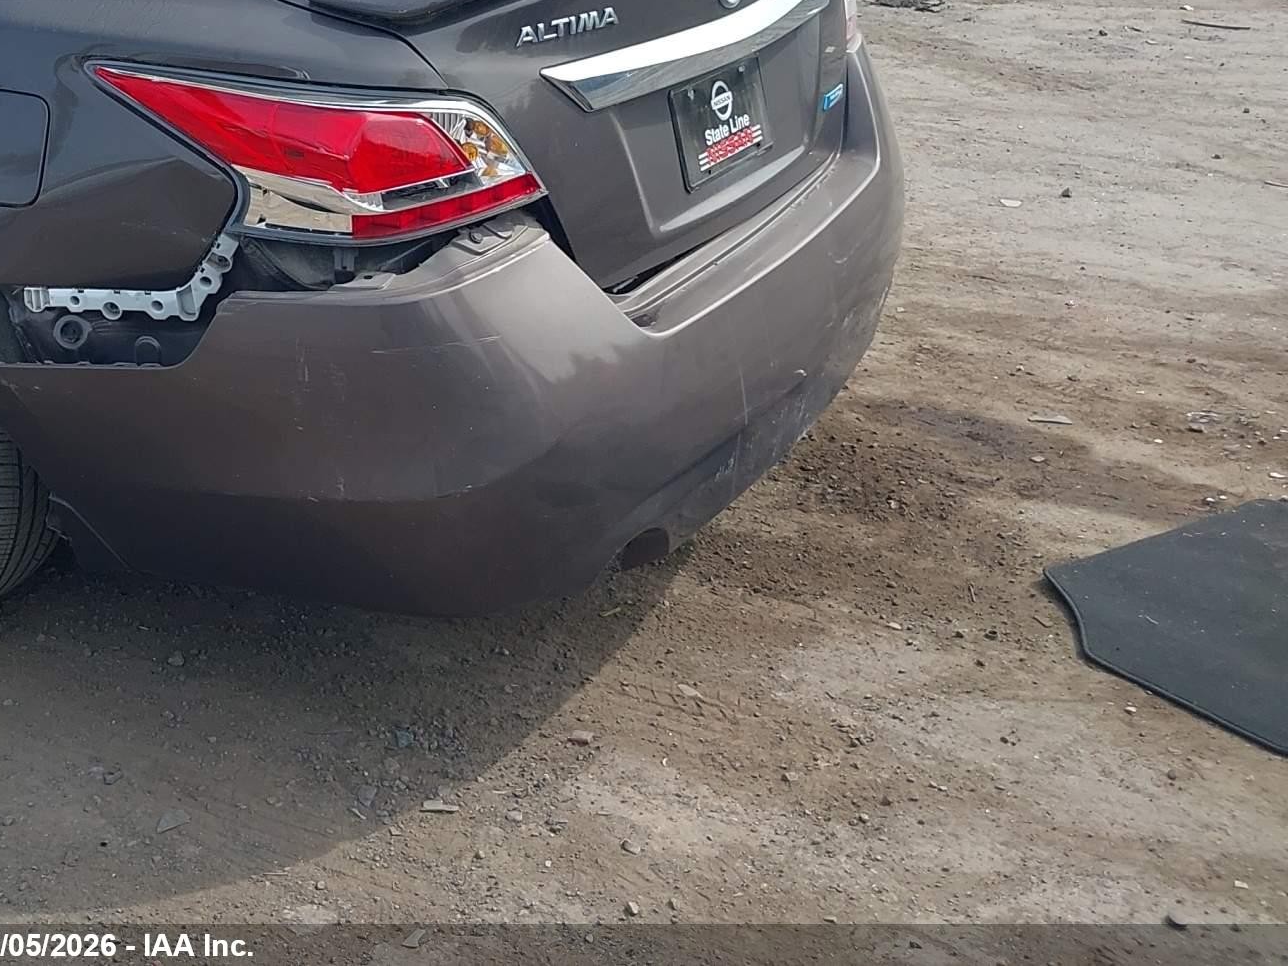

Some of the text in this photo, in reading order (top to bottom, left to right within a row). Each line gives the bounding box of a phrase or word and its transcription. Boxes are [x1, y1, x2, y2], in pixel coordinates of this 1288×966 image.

[516, 6, 619, 47] ALTIMA
[705, 114, 750, 146] State Line
